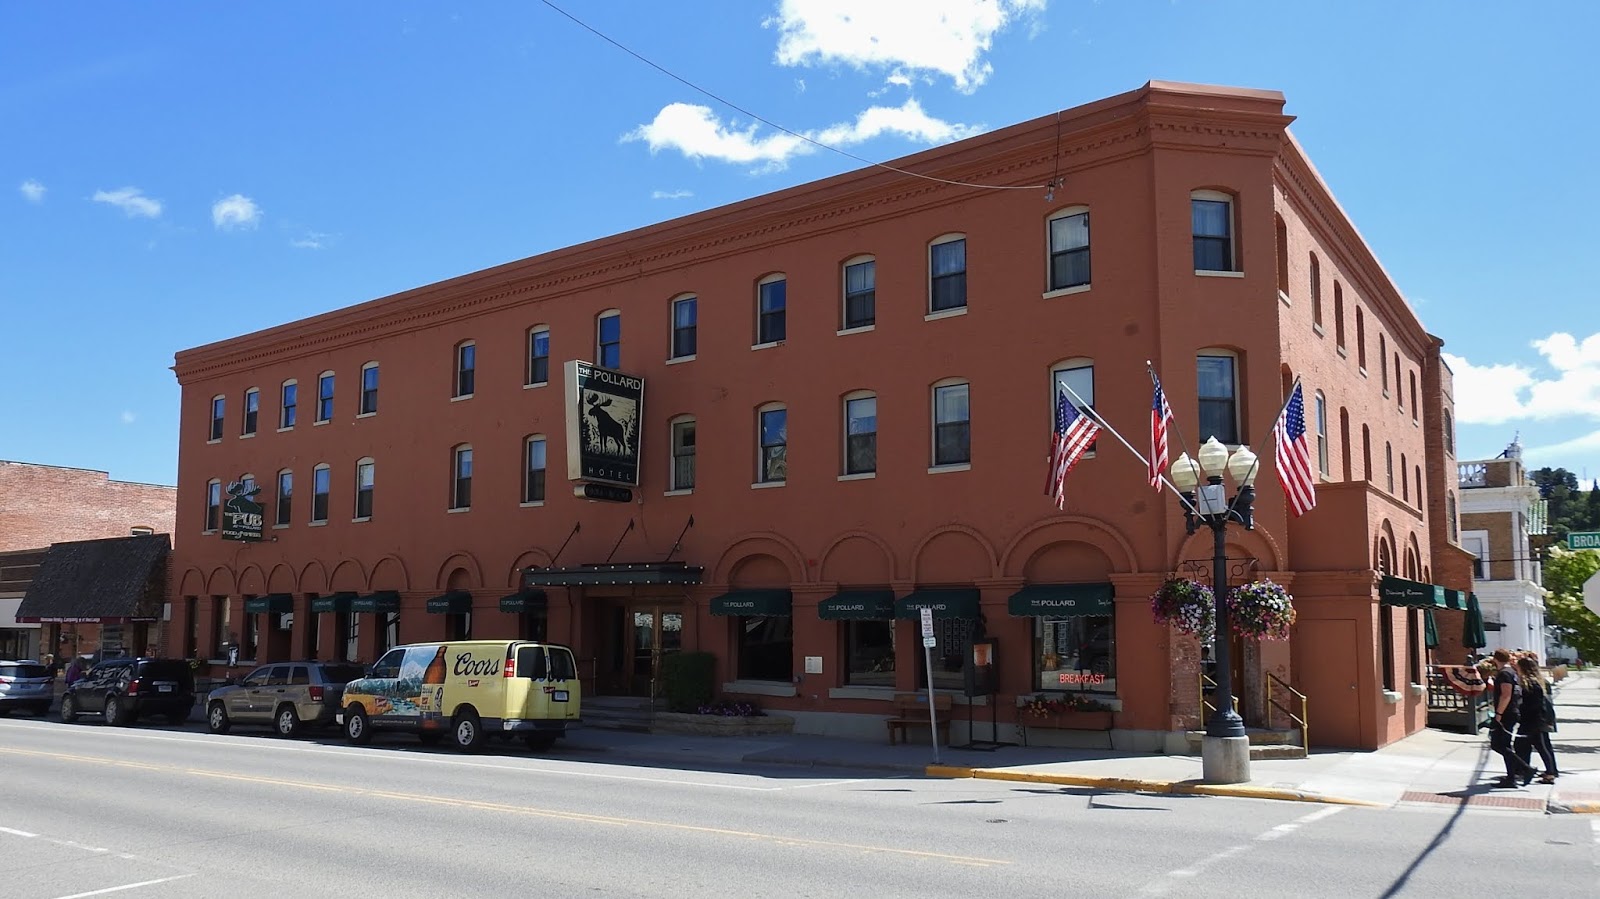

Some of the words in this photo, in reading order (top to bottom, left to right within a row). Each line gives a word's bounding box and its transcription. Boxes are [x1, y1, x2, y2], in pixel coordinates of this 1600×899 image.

[594, 370, 641, 390] POLLARD
[588, 467, 630, 480] HOTEL
[233, 512, 262, 526] PUB
[454, 652, 500, 676] Coors
[1060, 674, 1105, 684] BREAKFAST
